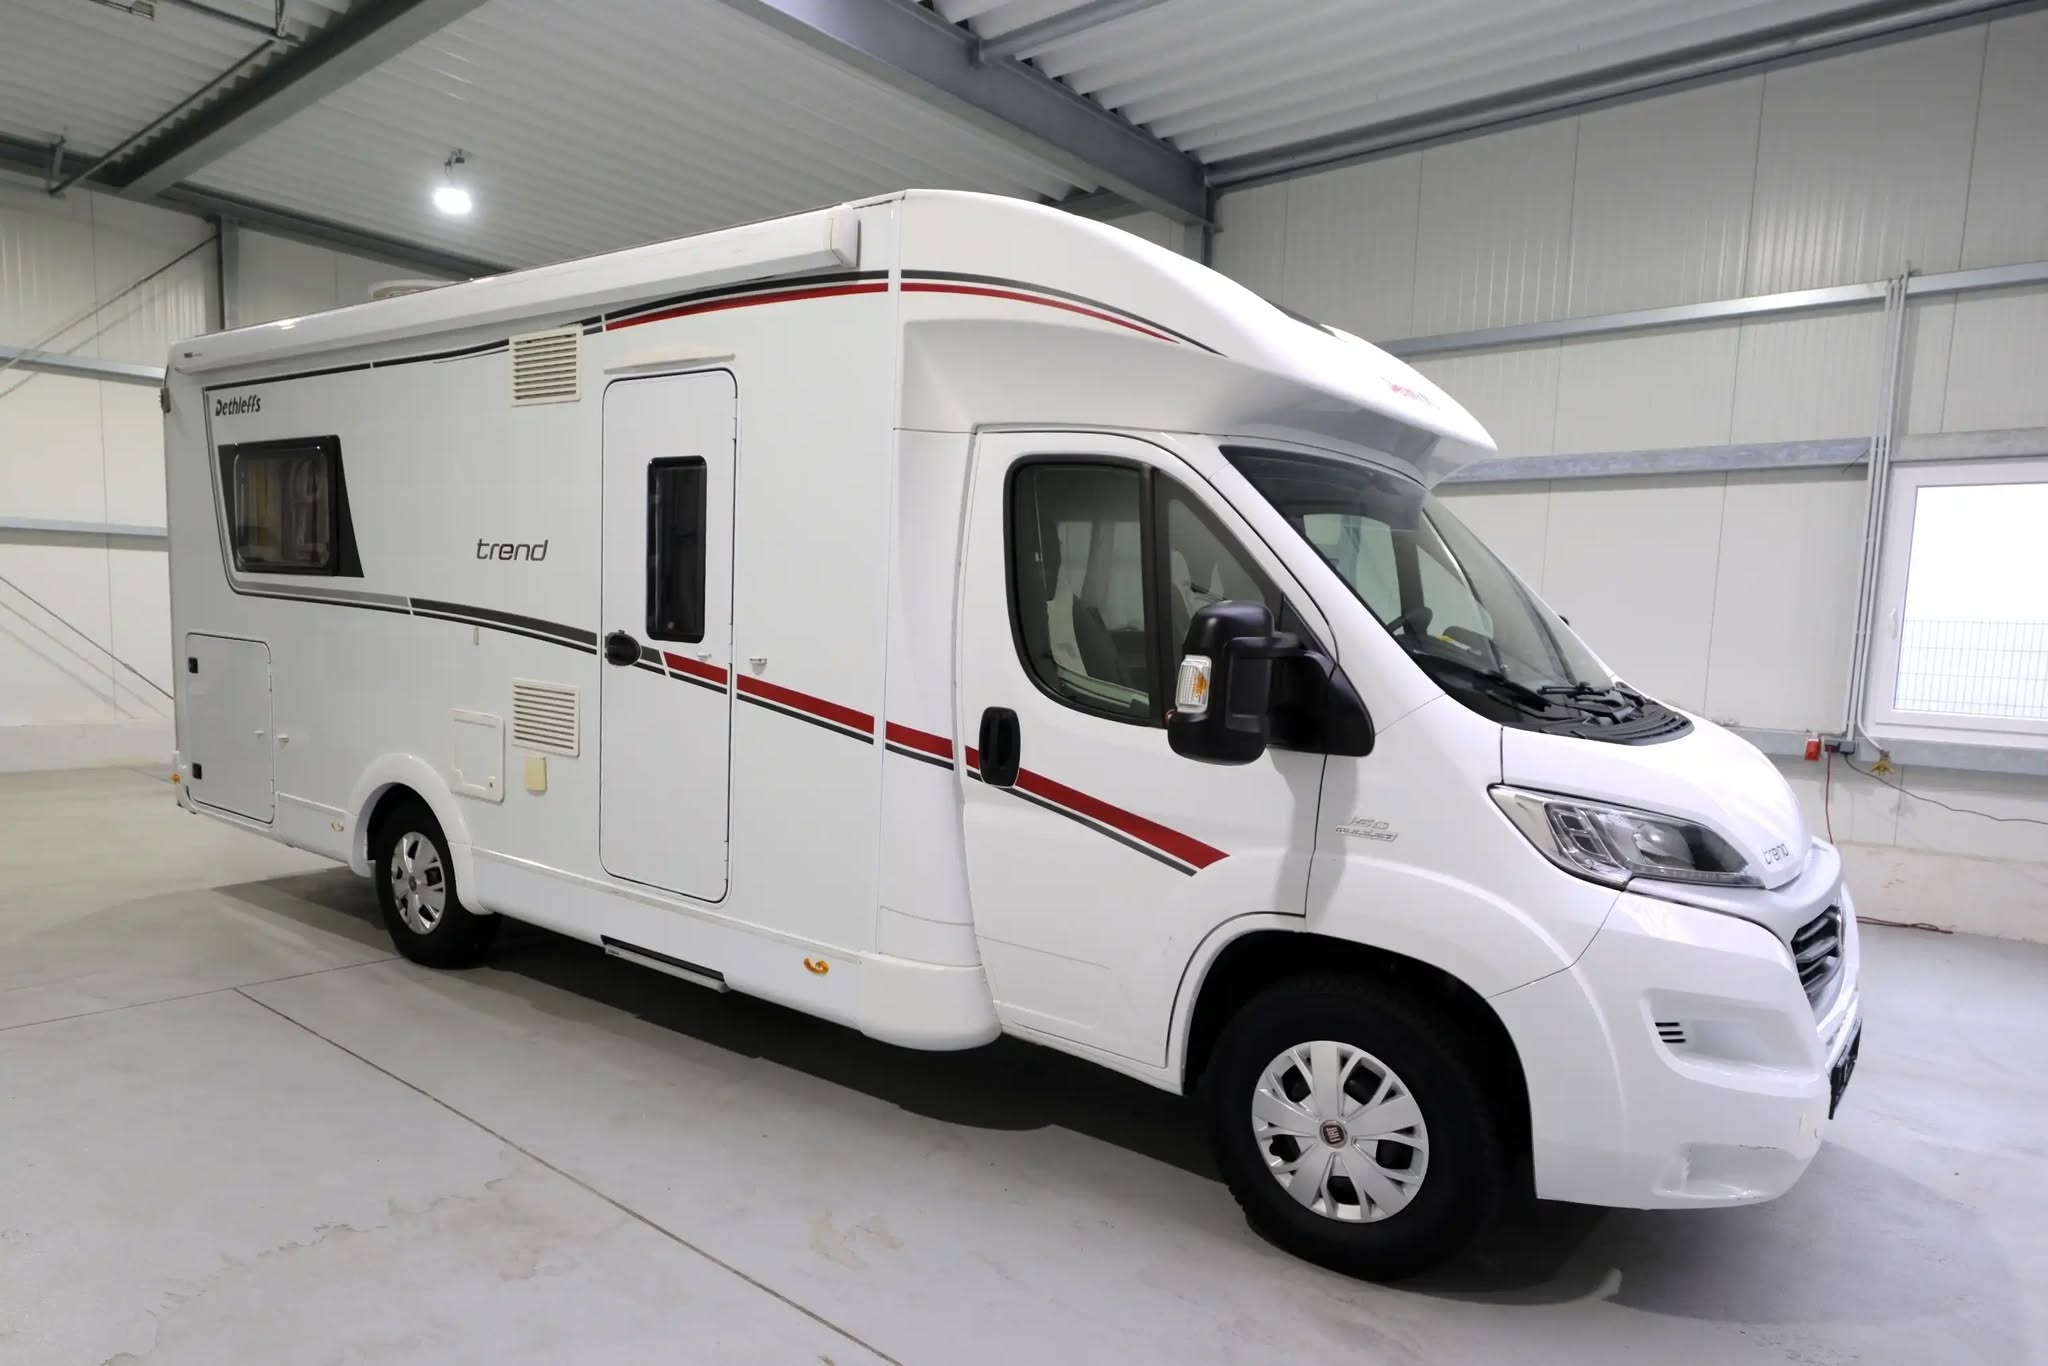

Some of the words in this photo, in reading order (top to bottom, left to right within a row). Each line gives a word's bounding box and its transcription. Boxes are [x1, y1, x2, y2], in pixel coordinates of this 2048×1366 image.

[215, 394, 261, 417] Dethleffs
[476, 538, 549, 561] trend
[1761, 842, 1789, 865] trend
[1326, 1126, 1342, 1143] FIAT
